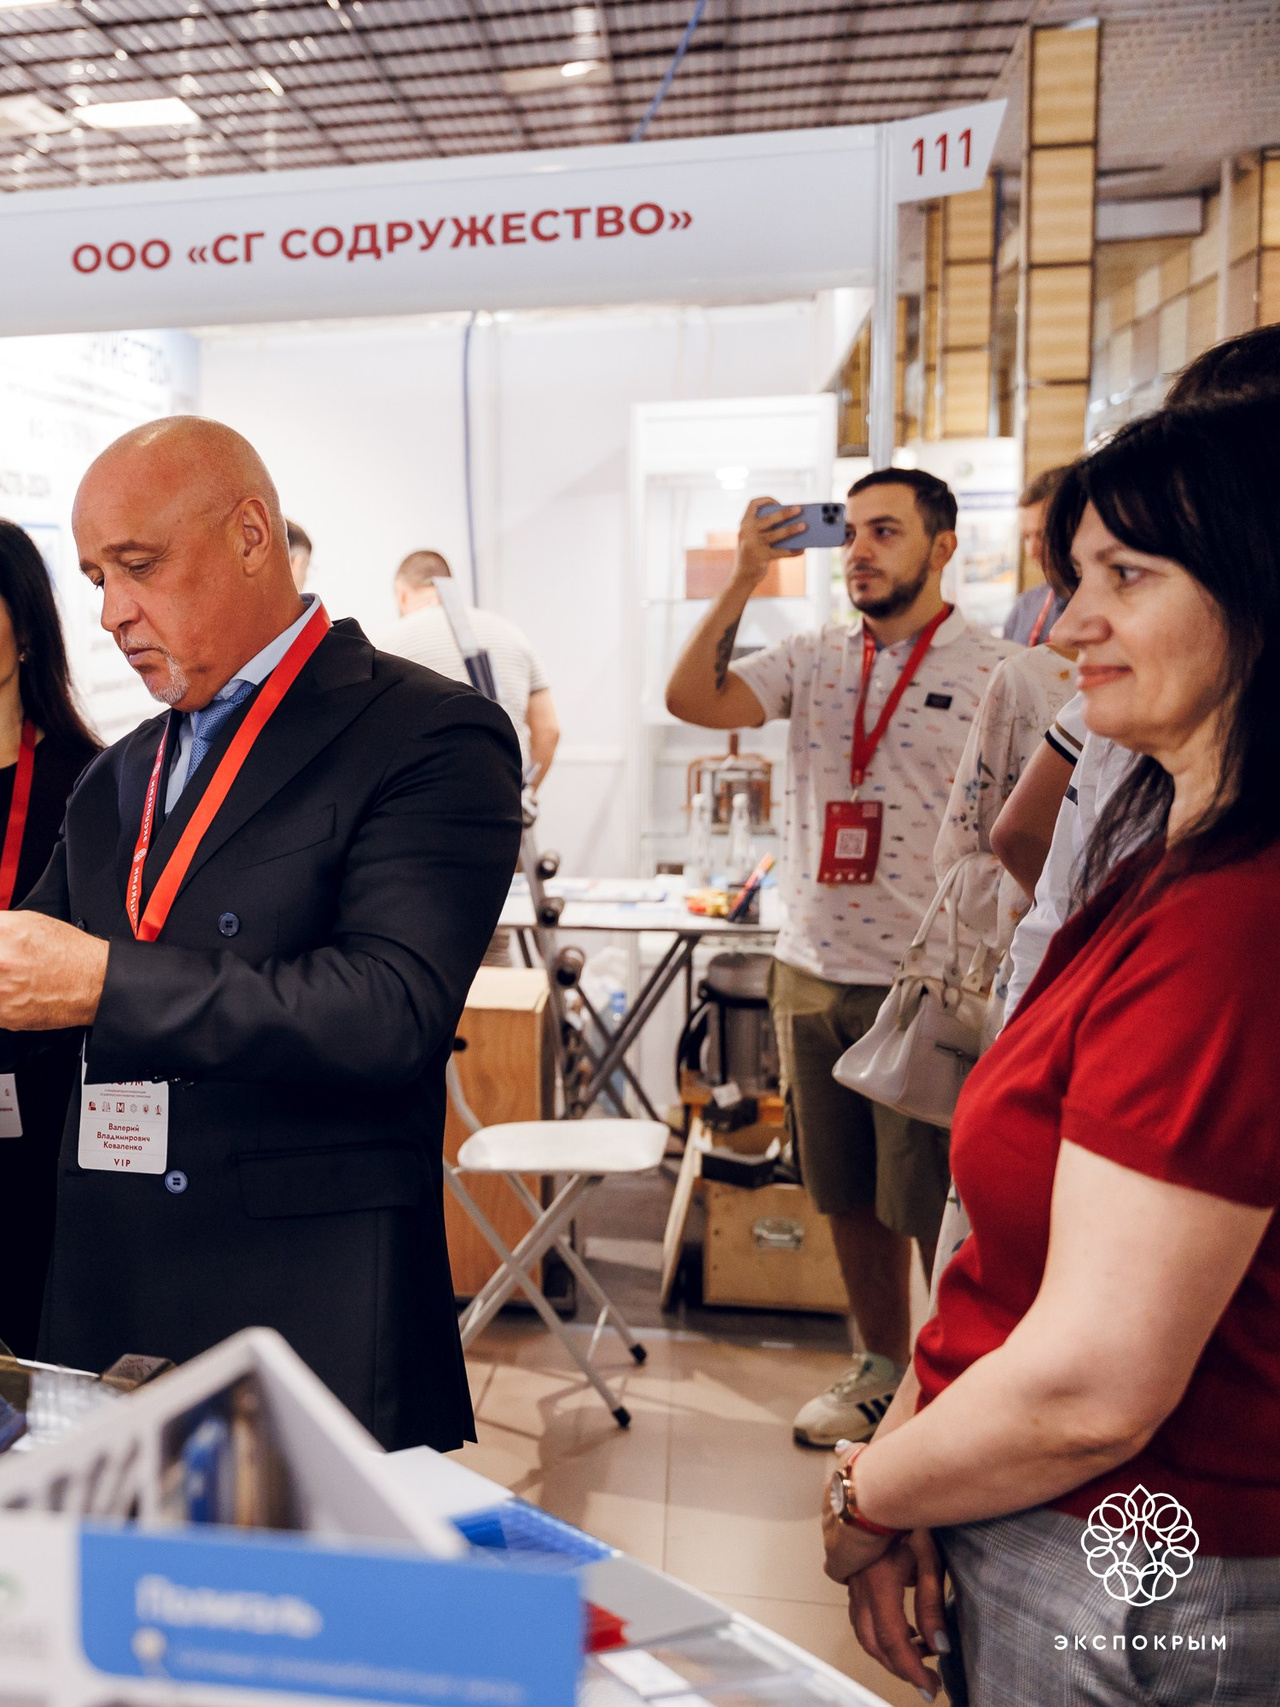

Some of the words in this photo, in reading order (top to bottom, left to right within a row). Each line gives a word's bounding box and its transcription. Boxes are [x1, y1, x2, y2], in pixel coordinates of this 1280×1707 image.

[911, 127, 971, 176] 111
[72, 239, 170, 273] ООО
[187, 232, 265, 264] «СГ
[280, 202, 692, 262] СОДРУЖЕСТВО»
[108, 1122, 140, 1133] Валерий
[96, 1131, 151, 1143] Владимирович
[103, 1141, 143, 1151] Коваленко
[113, 1158, 131, 1167] VIP
